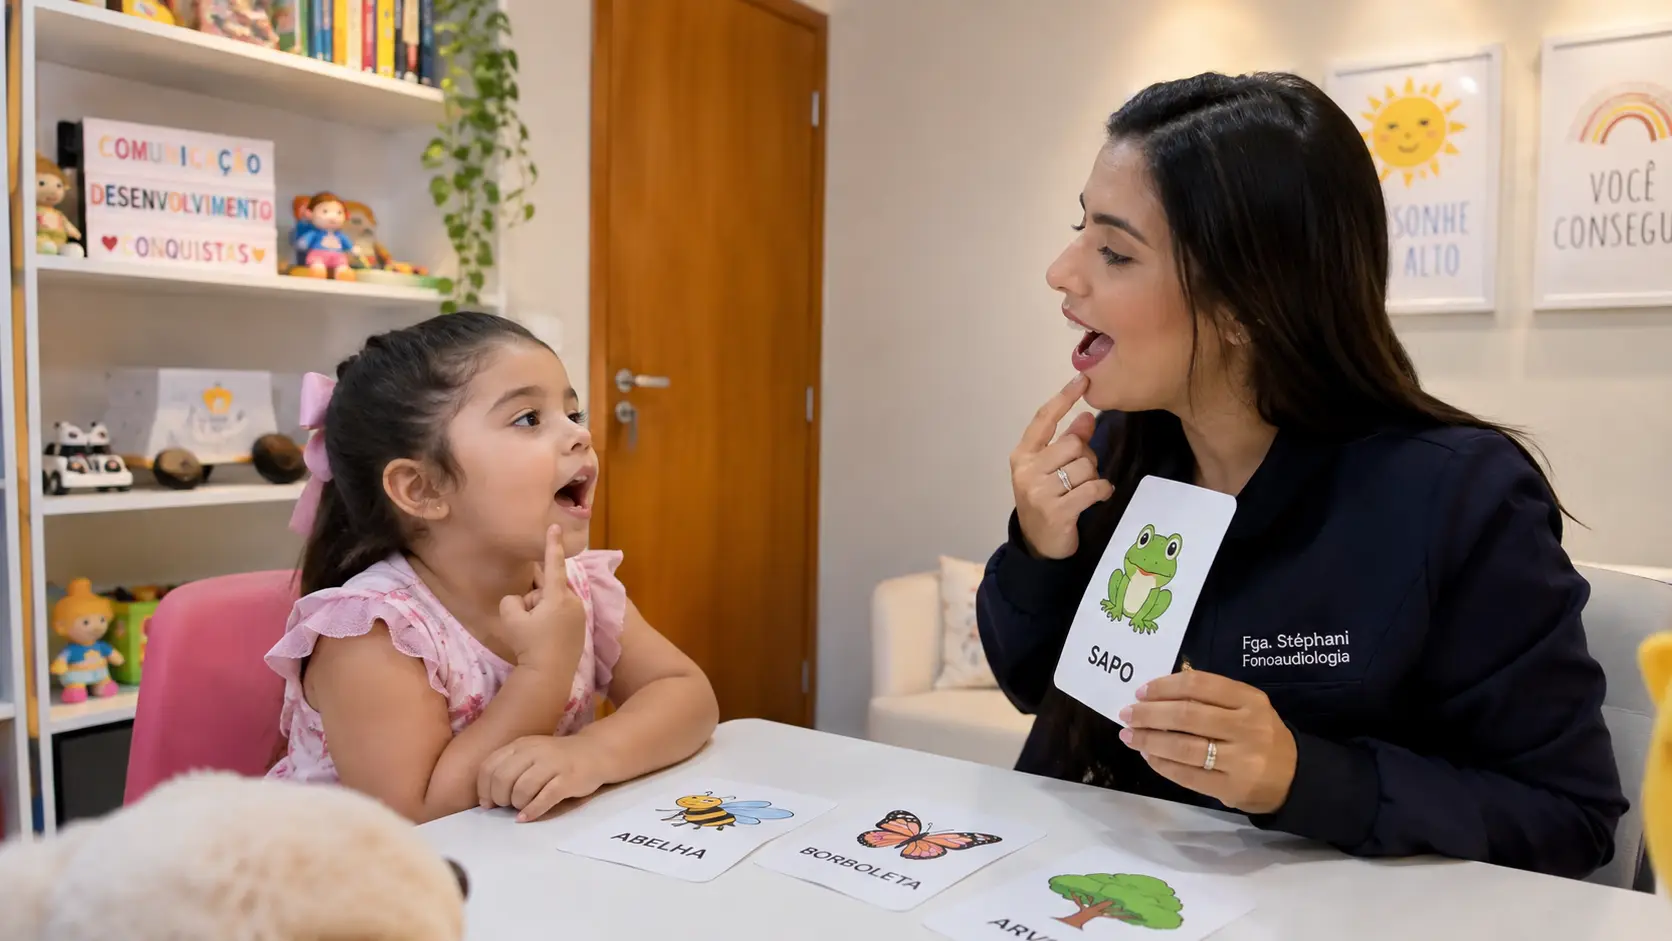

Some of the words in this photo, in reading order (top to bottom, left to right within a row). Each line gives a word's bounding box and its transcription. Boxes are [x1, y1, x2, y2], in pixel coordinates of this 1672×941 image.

[98, 134, 261, 176] COMUNICAÇÃO
[1589, 159, 1656, 204] VOCÊ
[90, 183, 272, 221] DESENVOLVIMENTO
[1392, 200, 1471, 239] SONHE
[121, 233, 249, 264] CONQUISTAS
[1553, 211, 1672, 250] CONSEGU
[1404, 243, 1461, 277] ALTO
[1242, 635, 1272, 653] Fga.
[1277, 630, 1350, 650] Stéphani
[1242, 650, 1350, 667] Fonoaudiologia
[1087, 645, 1134, 683] SAPO
[610, 831, 707, 860] ABELHA
[800, 846, 922, 892] BORBOLETA
[987, 918, 1058, 941] ARV
